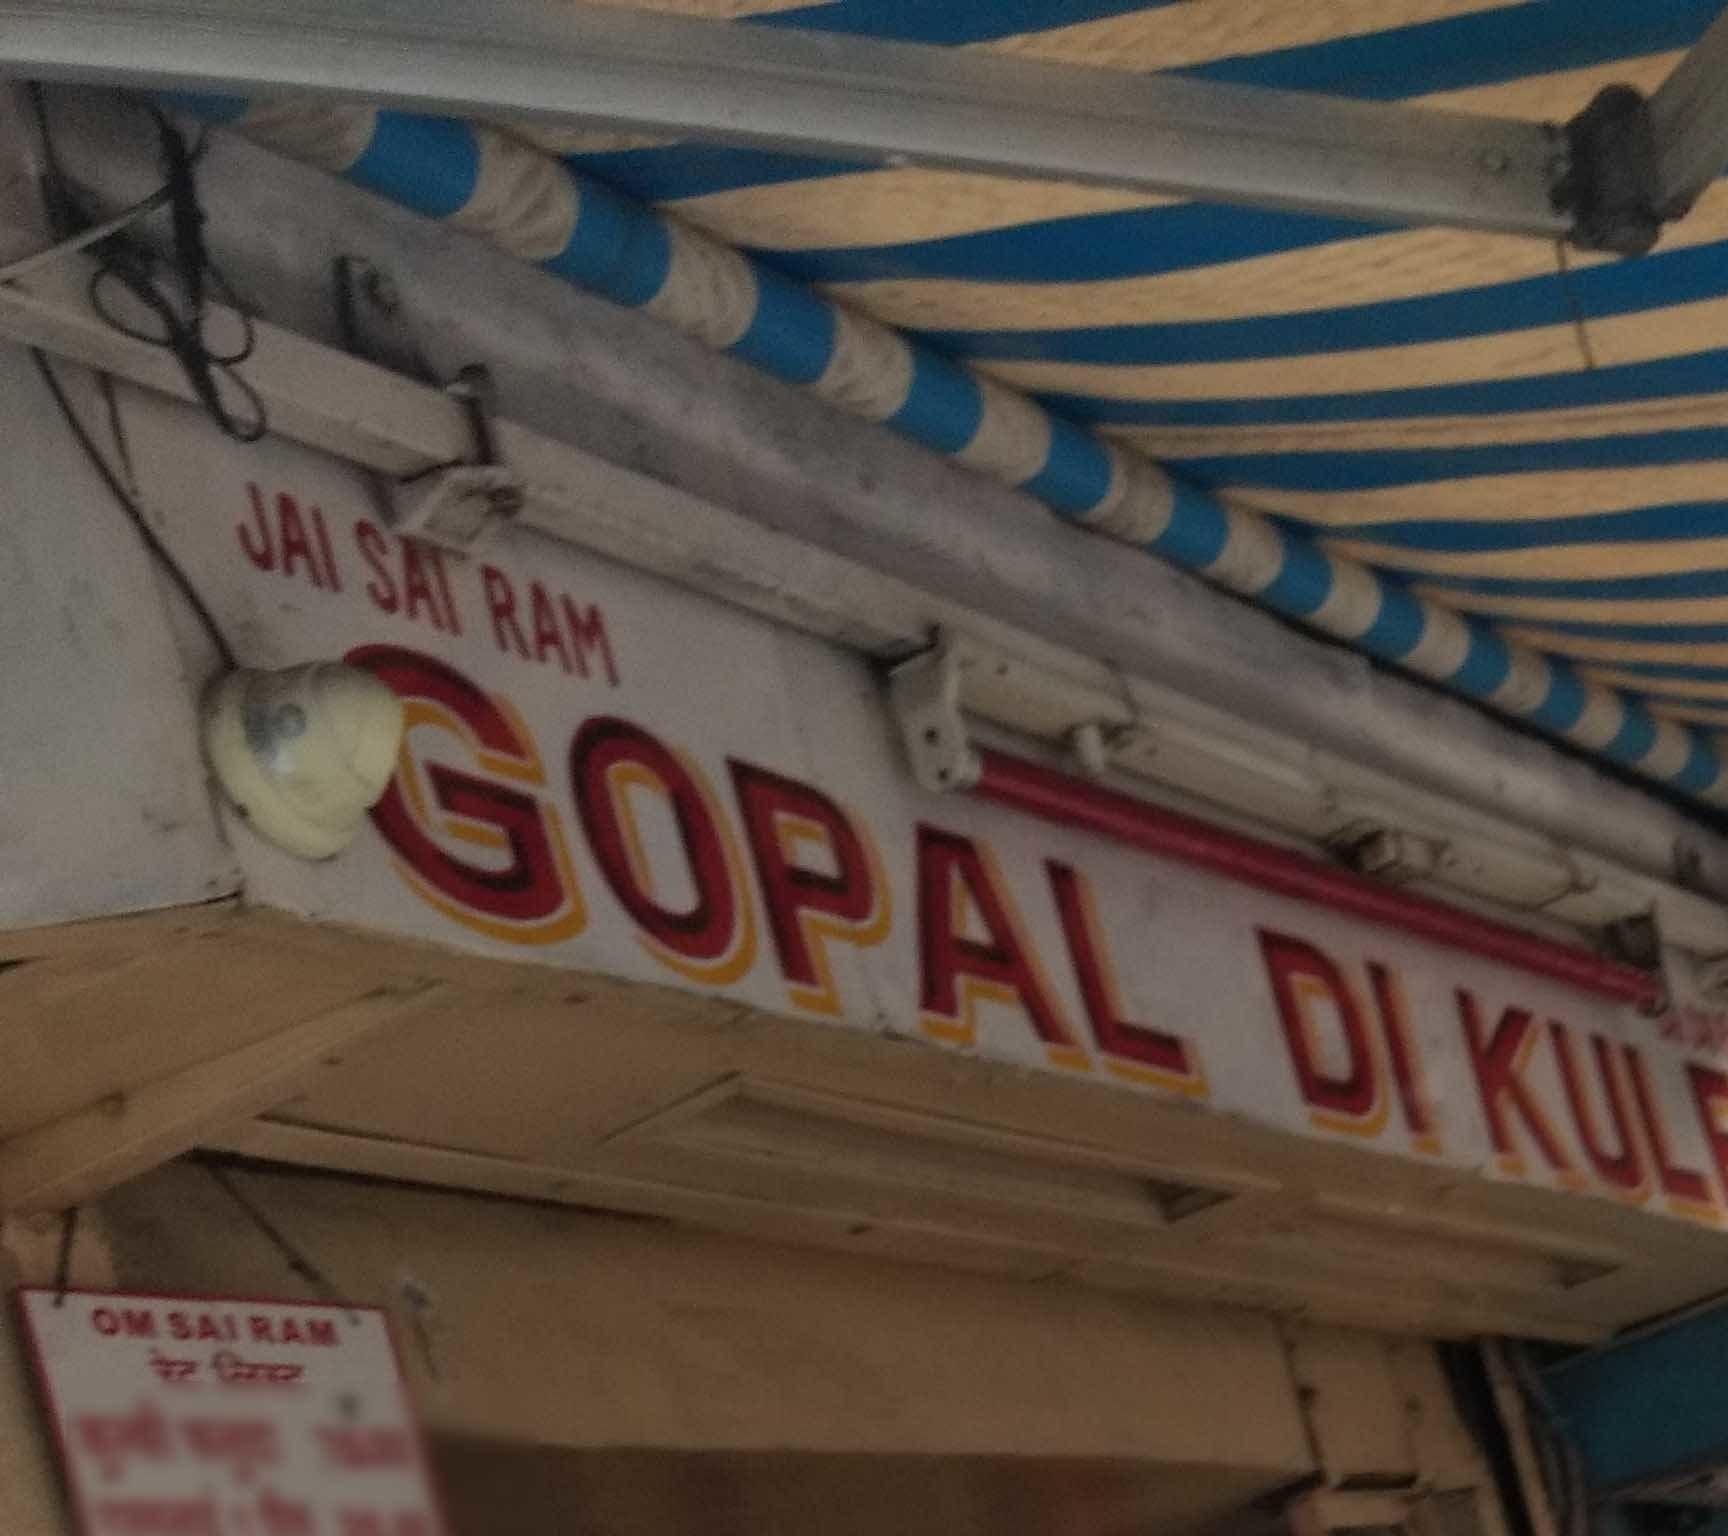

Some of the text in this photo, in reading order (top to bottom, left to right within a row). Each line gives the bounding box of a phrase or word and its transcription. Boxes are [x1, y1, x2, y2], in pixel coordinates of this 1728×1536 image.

[236, 481, 343, 593] JAI
[480, 564, 621, 688] RAM
[343, 643, 1209, 1097] GOPAL
[1256, 925, 1441, 1154] DI
[92, 1308, 340, 1347] OM SAI RAM
